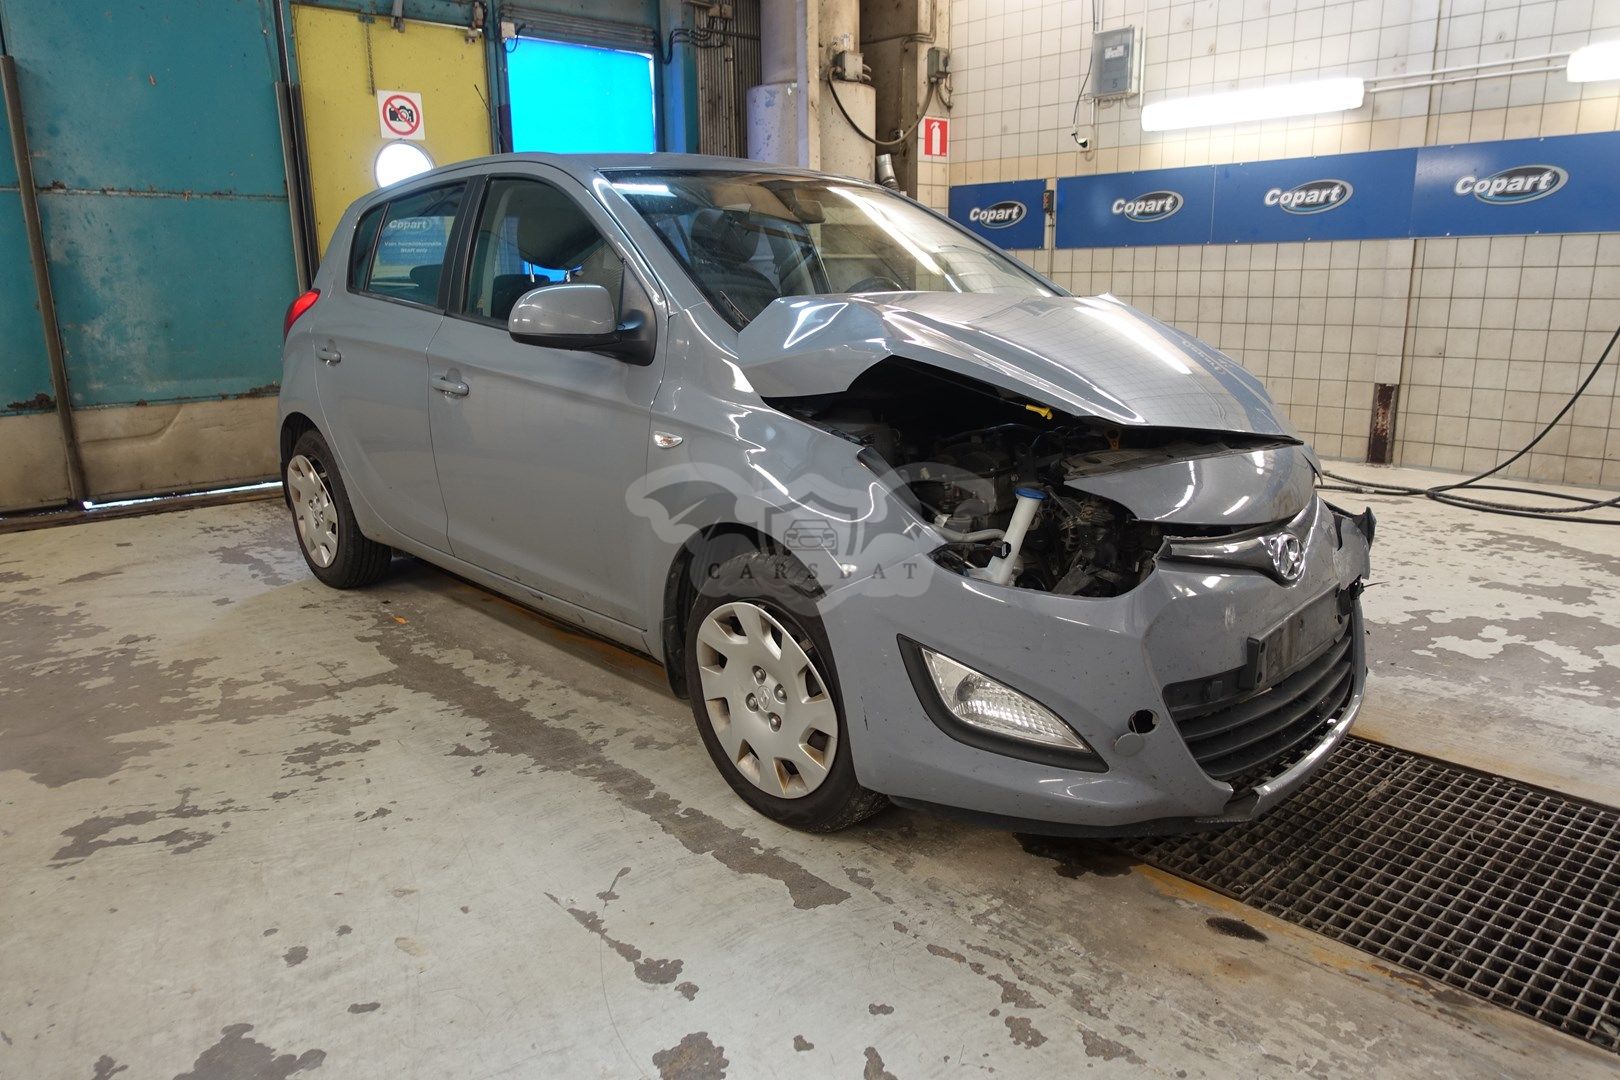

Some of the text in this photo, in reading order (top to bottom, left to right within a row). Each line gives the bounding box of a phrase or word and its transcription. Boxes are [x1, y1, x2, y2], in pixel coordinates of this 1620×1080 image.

[1456, 168, 1554, 198] Copart
[1112, 194, 1174, 217] Copart
[1264, 184, 1342, 207] Copart
[389, 219, 428, 230] Copart
[969, 206, 1020, 223] Copart
